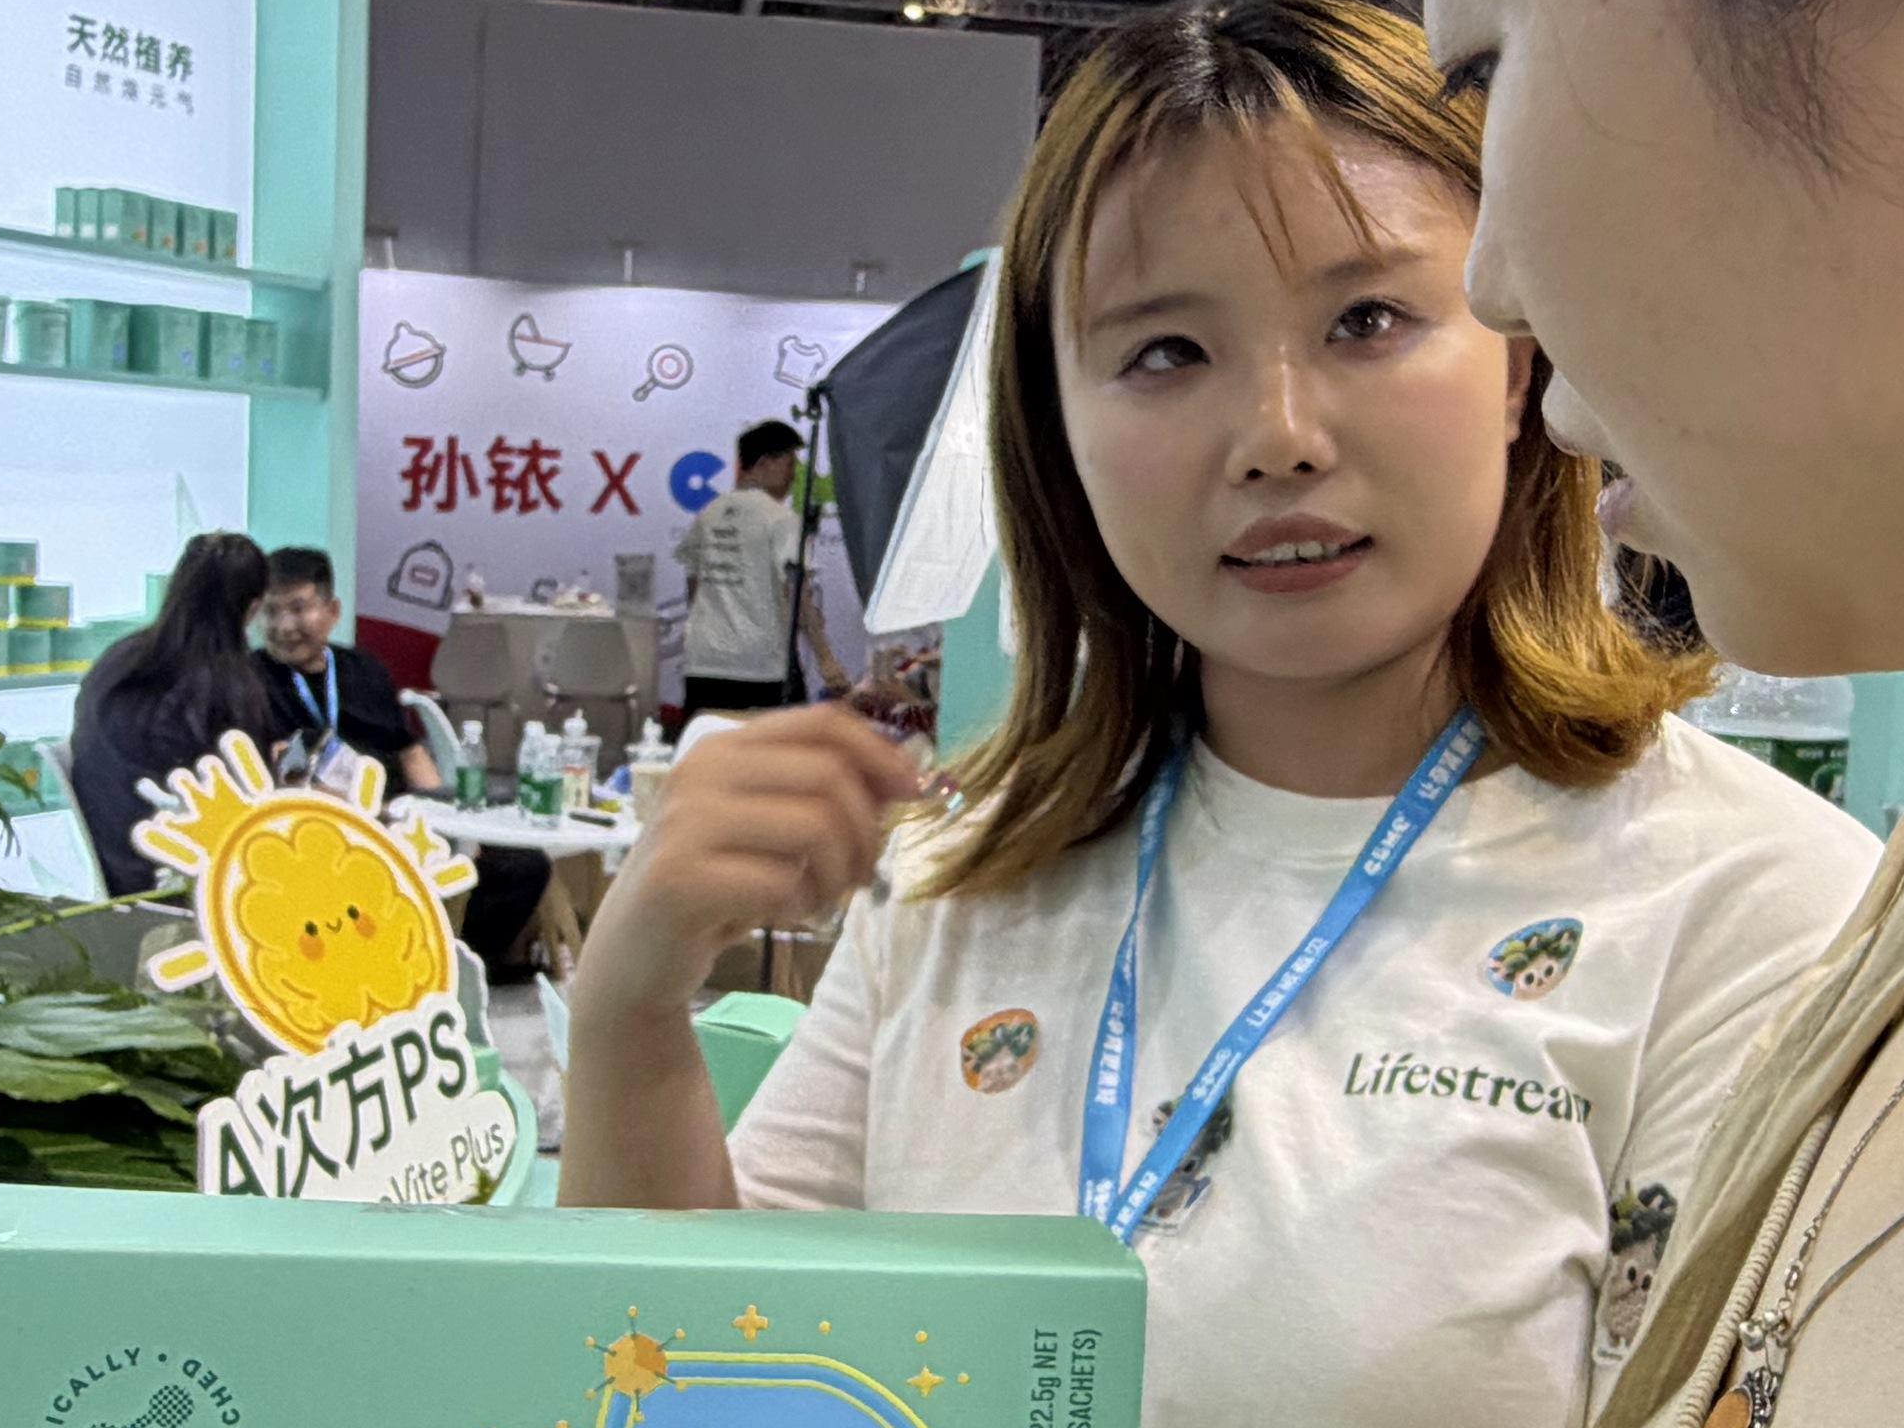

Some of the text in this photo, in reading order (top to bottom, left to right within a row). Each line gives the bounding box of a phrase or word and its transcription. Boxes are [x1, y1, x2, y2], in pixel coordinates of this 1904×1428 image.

[67, 12, 193, 82] 天然植养
[591, 452, 642, 515] X
[380, 1123, 504, 1204] Vite Plus
[1033, 1328, 1057, 1370] NET
